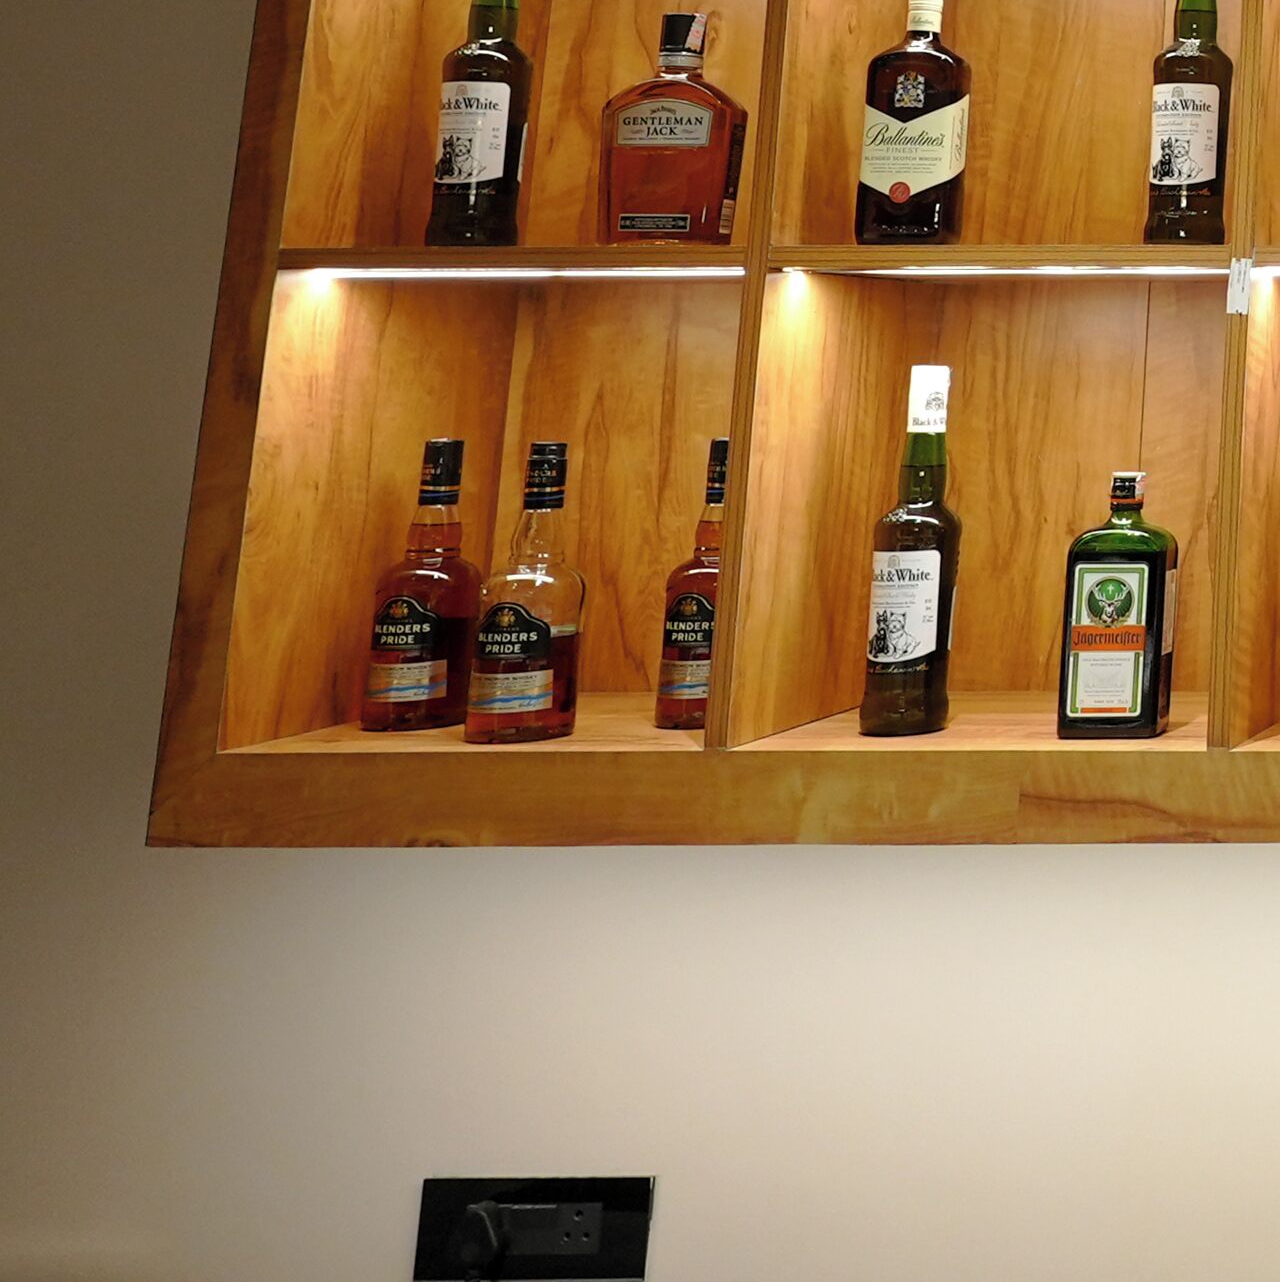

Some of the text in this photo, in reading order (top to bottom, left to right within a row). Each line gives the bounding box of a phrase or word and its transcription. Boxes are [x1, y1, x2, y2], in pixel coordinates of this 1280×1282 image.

[622, 116, 704, 127] GENTLEMAN
[646, 126, 679, 138] JACK
[864, 121, 945, 149] Ballantine's
[885, 146, 920, 154] FINEST
[380, 634, 415, 645] PRIDE
[671, 633, 704, 642] PRIDE
[485, 643, 522, 654] PRIDE
